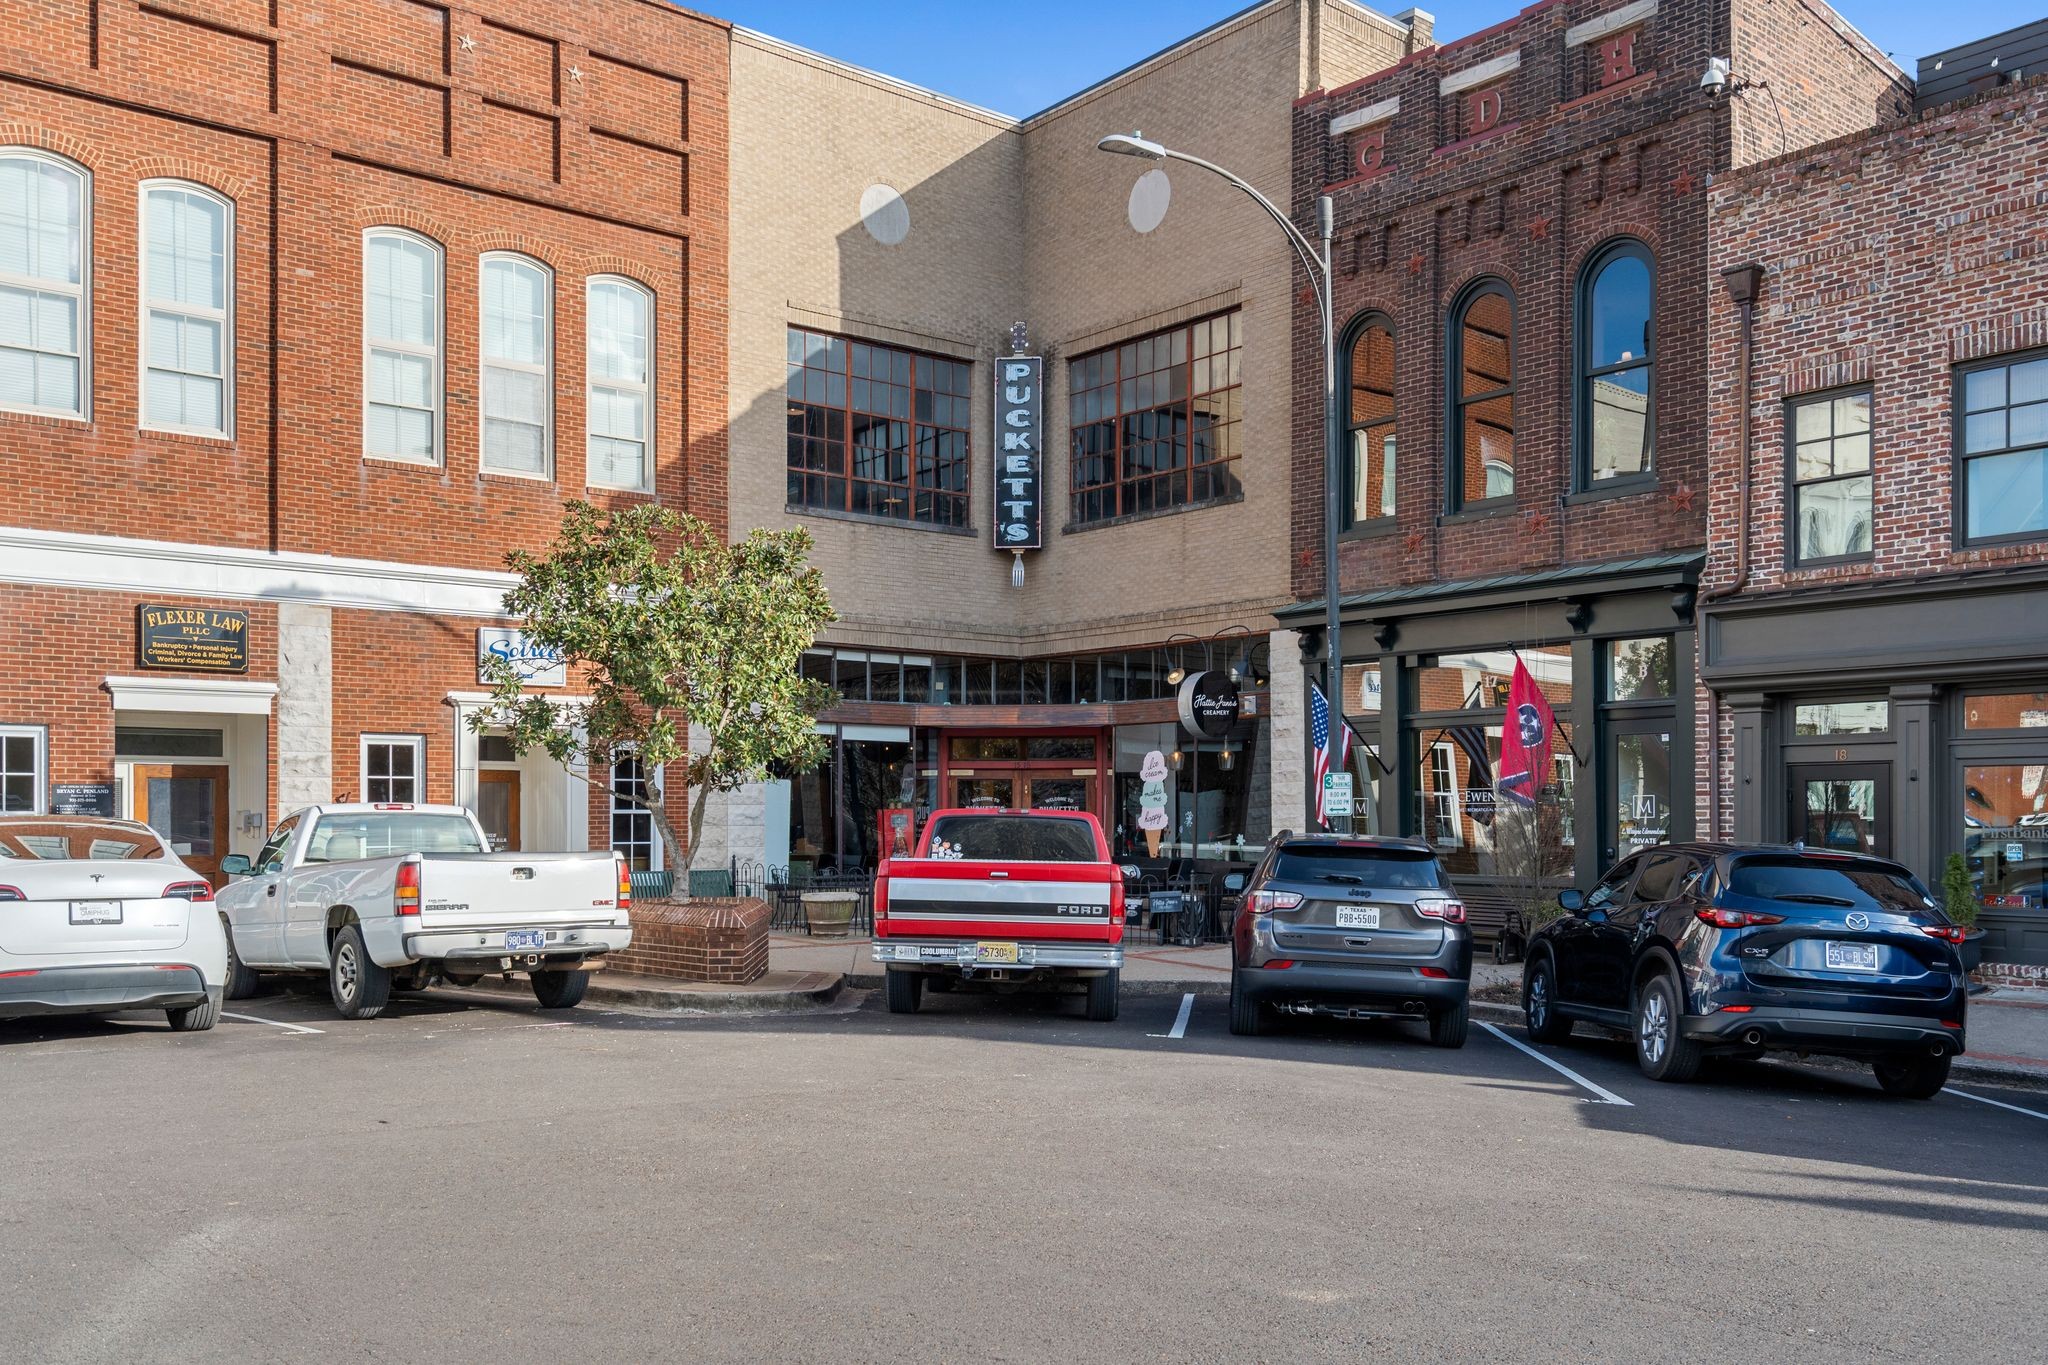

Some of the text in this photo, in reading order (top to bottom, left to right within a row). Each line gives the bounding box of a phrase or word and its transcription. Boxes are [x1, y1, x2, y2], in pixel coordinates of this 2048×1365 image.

[1001, 363, 1032, 543] PUCKETT'S
[147, 610, 244, 633] FLEXER LAW
[182, 626, 211, 636] PLLC
[152, 641, 238, 653] Bankruptcy Personal Injury
[147, 648, 176, 657] Criminal,
[177, 649, 202, 658] Divorce
[208, 651, 230, 660] Family
[186, 657, 231, 667] Compensation
[1193, 693, 1238, 710] Hattie Jane's
[1835, 749, 1847, 761] 18
[1144, 770, 1164, 779] cream
[1325, 776, 1333, 788] 3
[1144, 784, 1163, 798] makes
[1144, 810, 1162, 825] happy
[1982, 826, 2048, 839] FirstBank
[1630, 837, 1657, 845] PRIVATE
[1348, 888, 1372, 899] Jeep
[1057, 905, 1103, 915] FORD
[508, 932, 544, 945] 980 BLTP
[920, 947, 957, 956] COOLUMBIA!
[1829, 949, 1845, 962] 551
